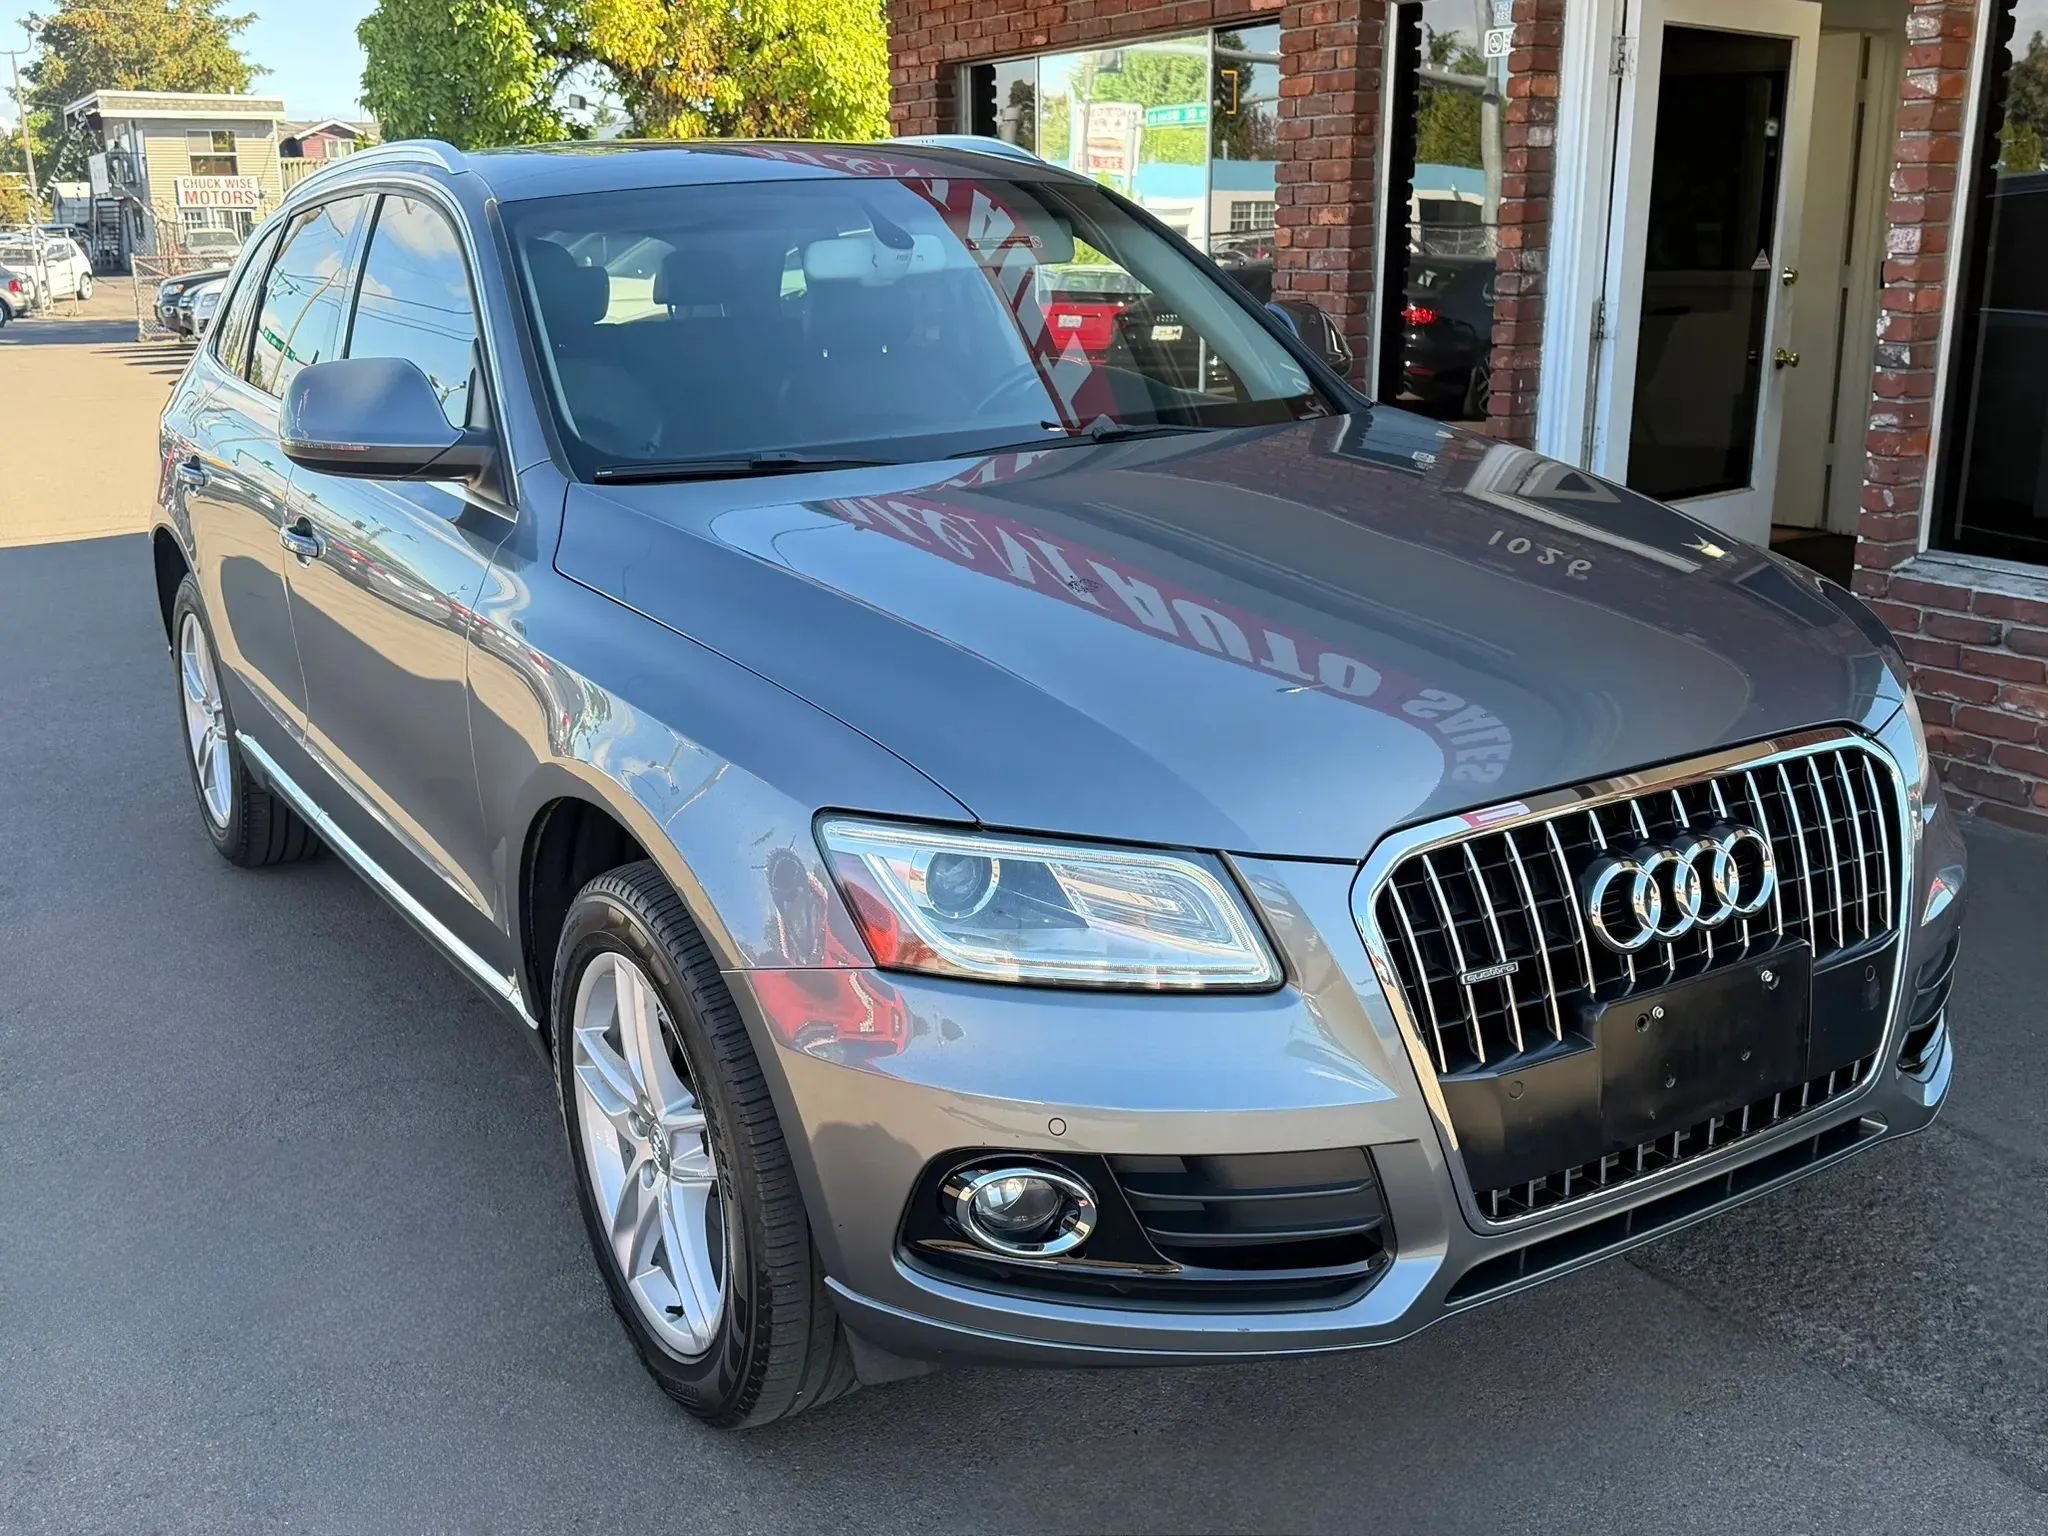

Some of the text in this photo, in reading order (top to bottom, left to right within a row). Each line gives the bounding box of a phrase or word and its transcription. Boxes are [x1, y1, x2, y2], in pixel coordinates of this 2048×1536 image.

[182, 178, 254, 190] CHUCK WISE
[184, 190, 255, 206] MOTORS
[1465, 964, 1515, 982] quattro
